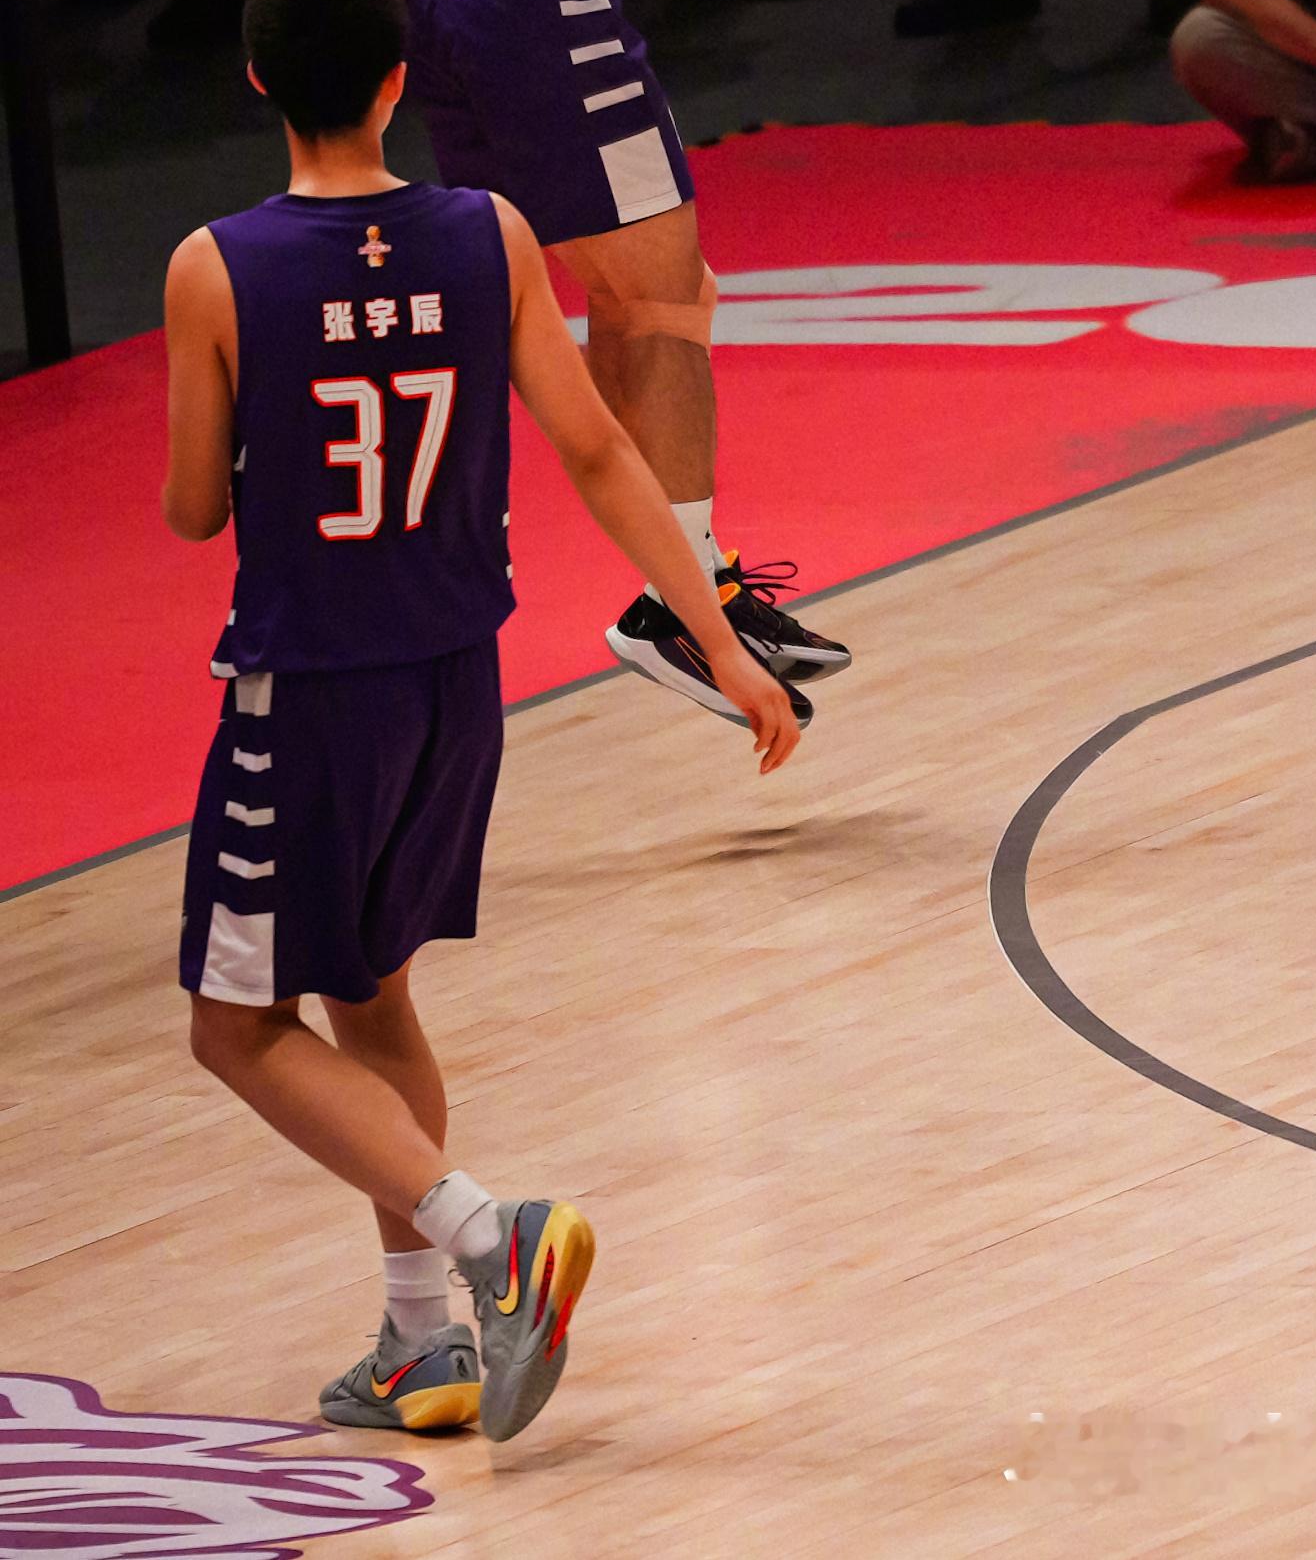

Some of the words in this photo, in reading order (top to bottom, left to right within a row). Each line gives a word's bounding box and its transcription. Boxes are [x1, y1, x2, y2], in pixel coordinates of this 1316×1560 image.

[322, 292, 444, 342] 张宇辰
[311, 367, 457, 541] 37
